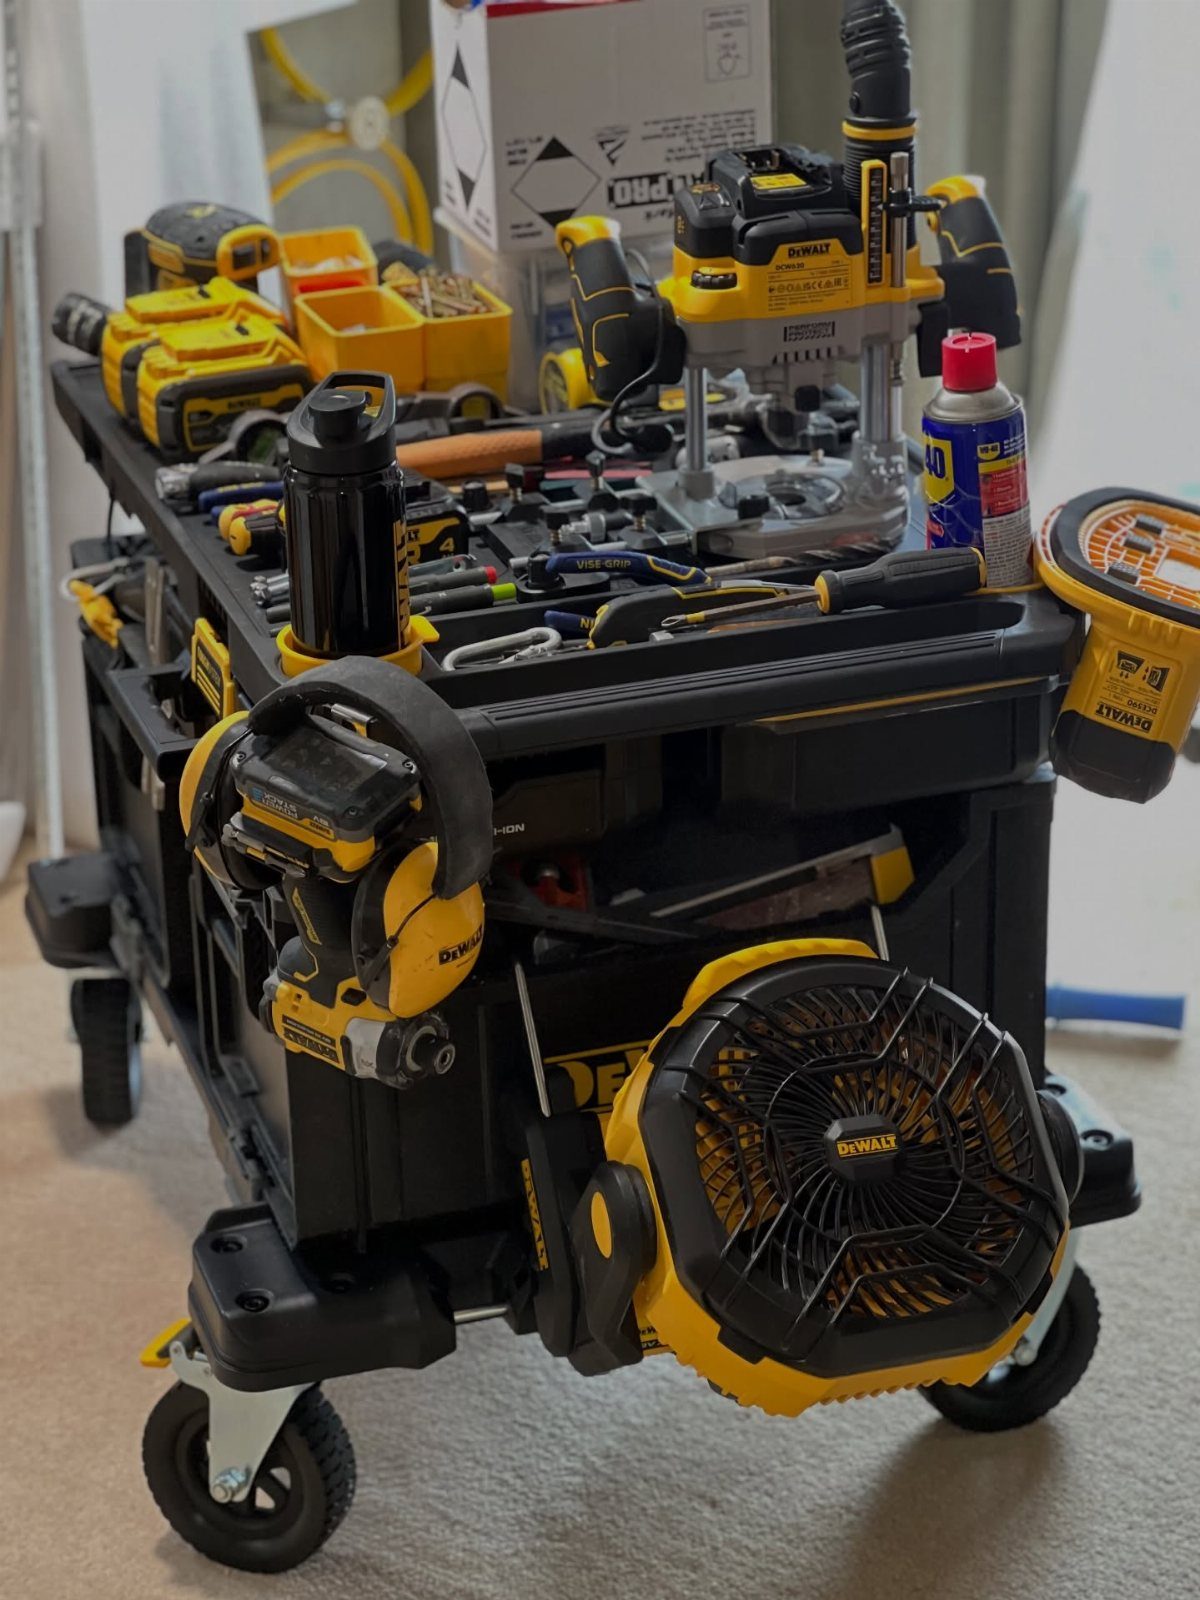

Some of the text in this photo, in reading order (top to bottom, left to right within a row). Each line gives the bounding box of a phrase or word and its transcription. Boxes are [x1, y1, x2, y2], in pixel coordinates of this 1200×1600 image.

[788, 242, 831, 258] DEWALT
[439, 537, 455, 552] 4
[576, 558, 631, 570] VISE-GRIP
[1127, 700, 1157, 715] DCE590
[1096, 703, 1153, 733] DEWALT
[493, 822, 526, 837] I-ION
[837, 1135, 897, 1155] DEWALT
